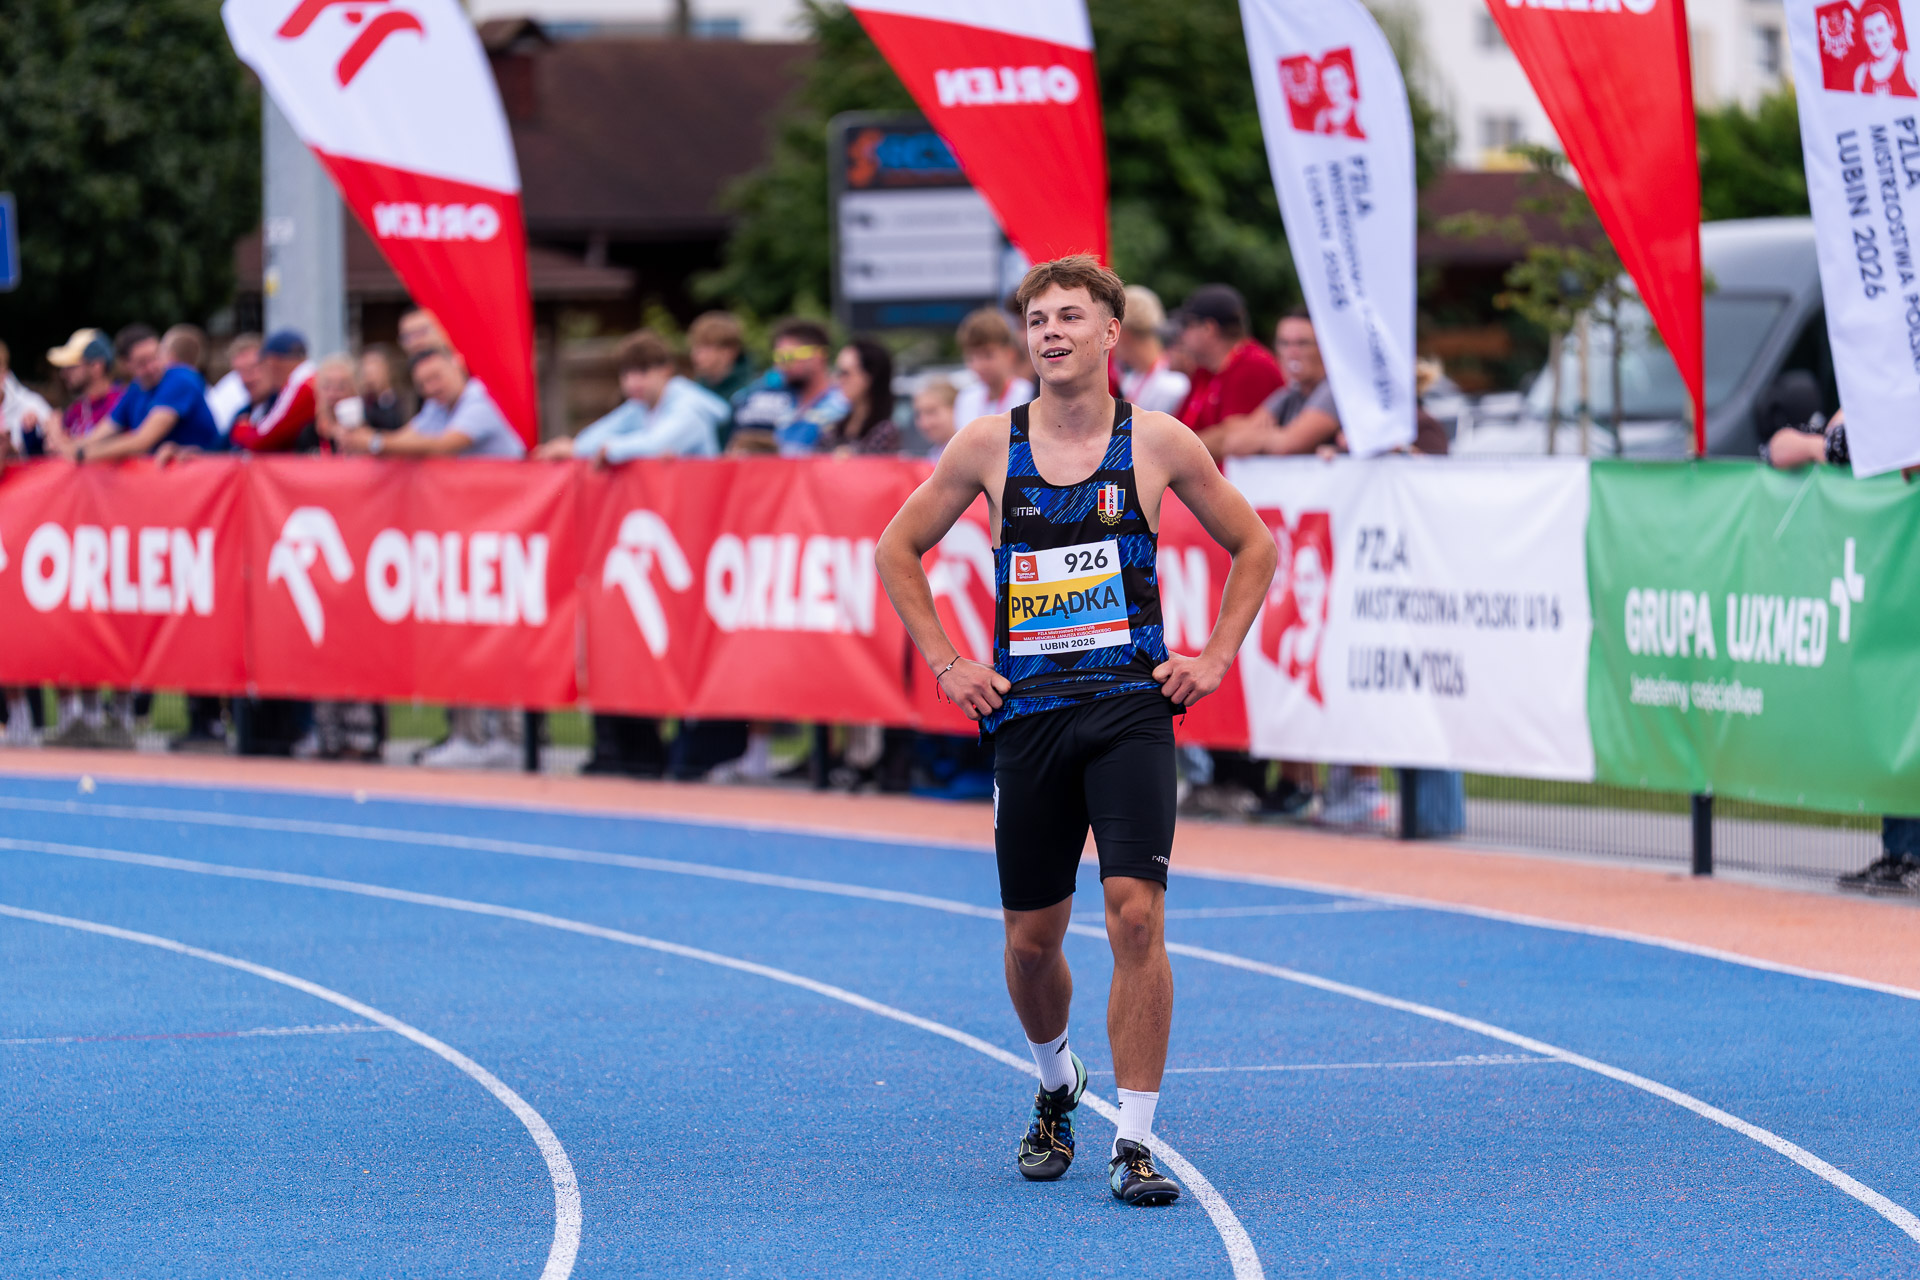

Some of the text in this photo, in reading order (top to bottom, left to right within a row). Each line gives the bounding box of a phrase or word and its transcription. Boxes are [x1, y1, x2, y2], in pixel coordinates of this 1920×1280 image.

[1894, 115, 1920, 191] PZLA
[1836, 129, 1887, 299] LUBIN 2026
[1869, 124, 1916, 289] MISTRZOSTWA
[21, 521, 215, 617] ORLEN
[365, 527, 549, 627] ORLEN
[704, 533, 878, 637] ORLEN
[1064, 548, 1108, 573] 926
[1011, 585, 1120, 619] PRZĄDKA
[1523, 594, 1563, 632] U16
[1624, 587, 1717, 660] GRUPA
[1040, 638, 1096, 651] LUBIN 2026
[1349, 646, 1421, 691] LUBIN
